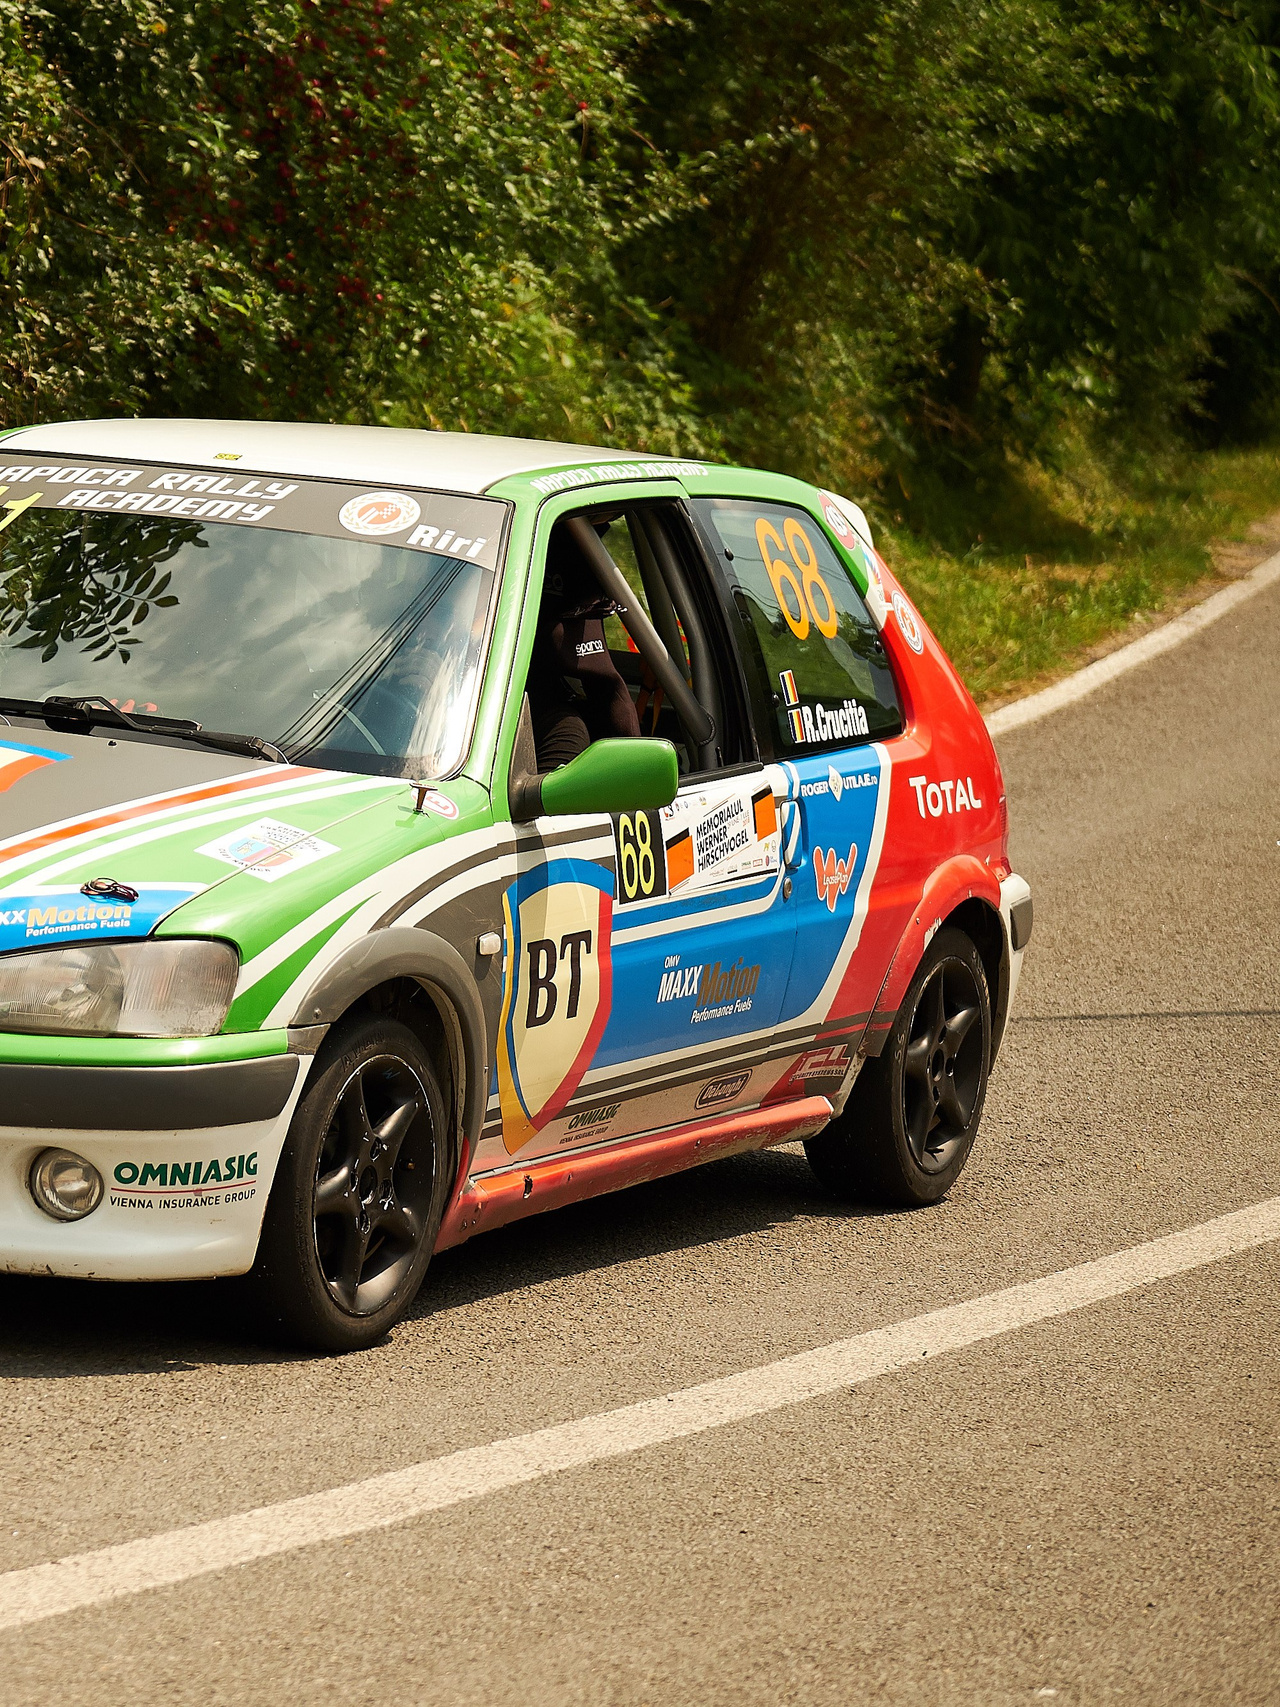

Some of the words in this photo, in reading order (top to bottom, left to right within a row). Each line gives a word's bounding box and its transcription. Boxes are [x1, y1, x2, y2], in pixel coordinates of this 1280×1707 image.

[148, 473, 299, 499] RALLY
[530, 468, 595, 494] NAPOCA
[589, 463, 642, 480] RALLY
[638, 462, 708, 477] ACADEMY
[57, 489, 276, 521] ACADEMY
[406, 525, 487, 559] Riri
[755, 517, 839, 640] 68
[801, 781, 829, 797] ROGER
[909, 775, 982, 819] TOTAL
[696, 799, 744, 841] MEMORIALUL
[619, 809, 655, 898] 68
[697, 825, 728, 856] WERNER
[698, 829, 749, 873] HIRSCHVOGEL
[25, 922, 97, 937] Performance
[100, 919, 131, 928] Fuels
[664, 955, 680, 969] OMV
[526, 930, 591, 1028] BT
[690, 1005, 733, 1024] Performance
[734, 998, 752, 1013] Fuels
[568, 1103, 621, 1130] OMNIASIG
[113, 1151, 258, 1187] OMNIASIG
[110, 1195, 154, 1209] VIENNA
[159, 1194, 220, 1209] INSURANCE
[225, 1188, 256, 1204] GROUP
